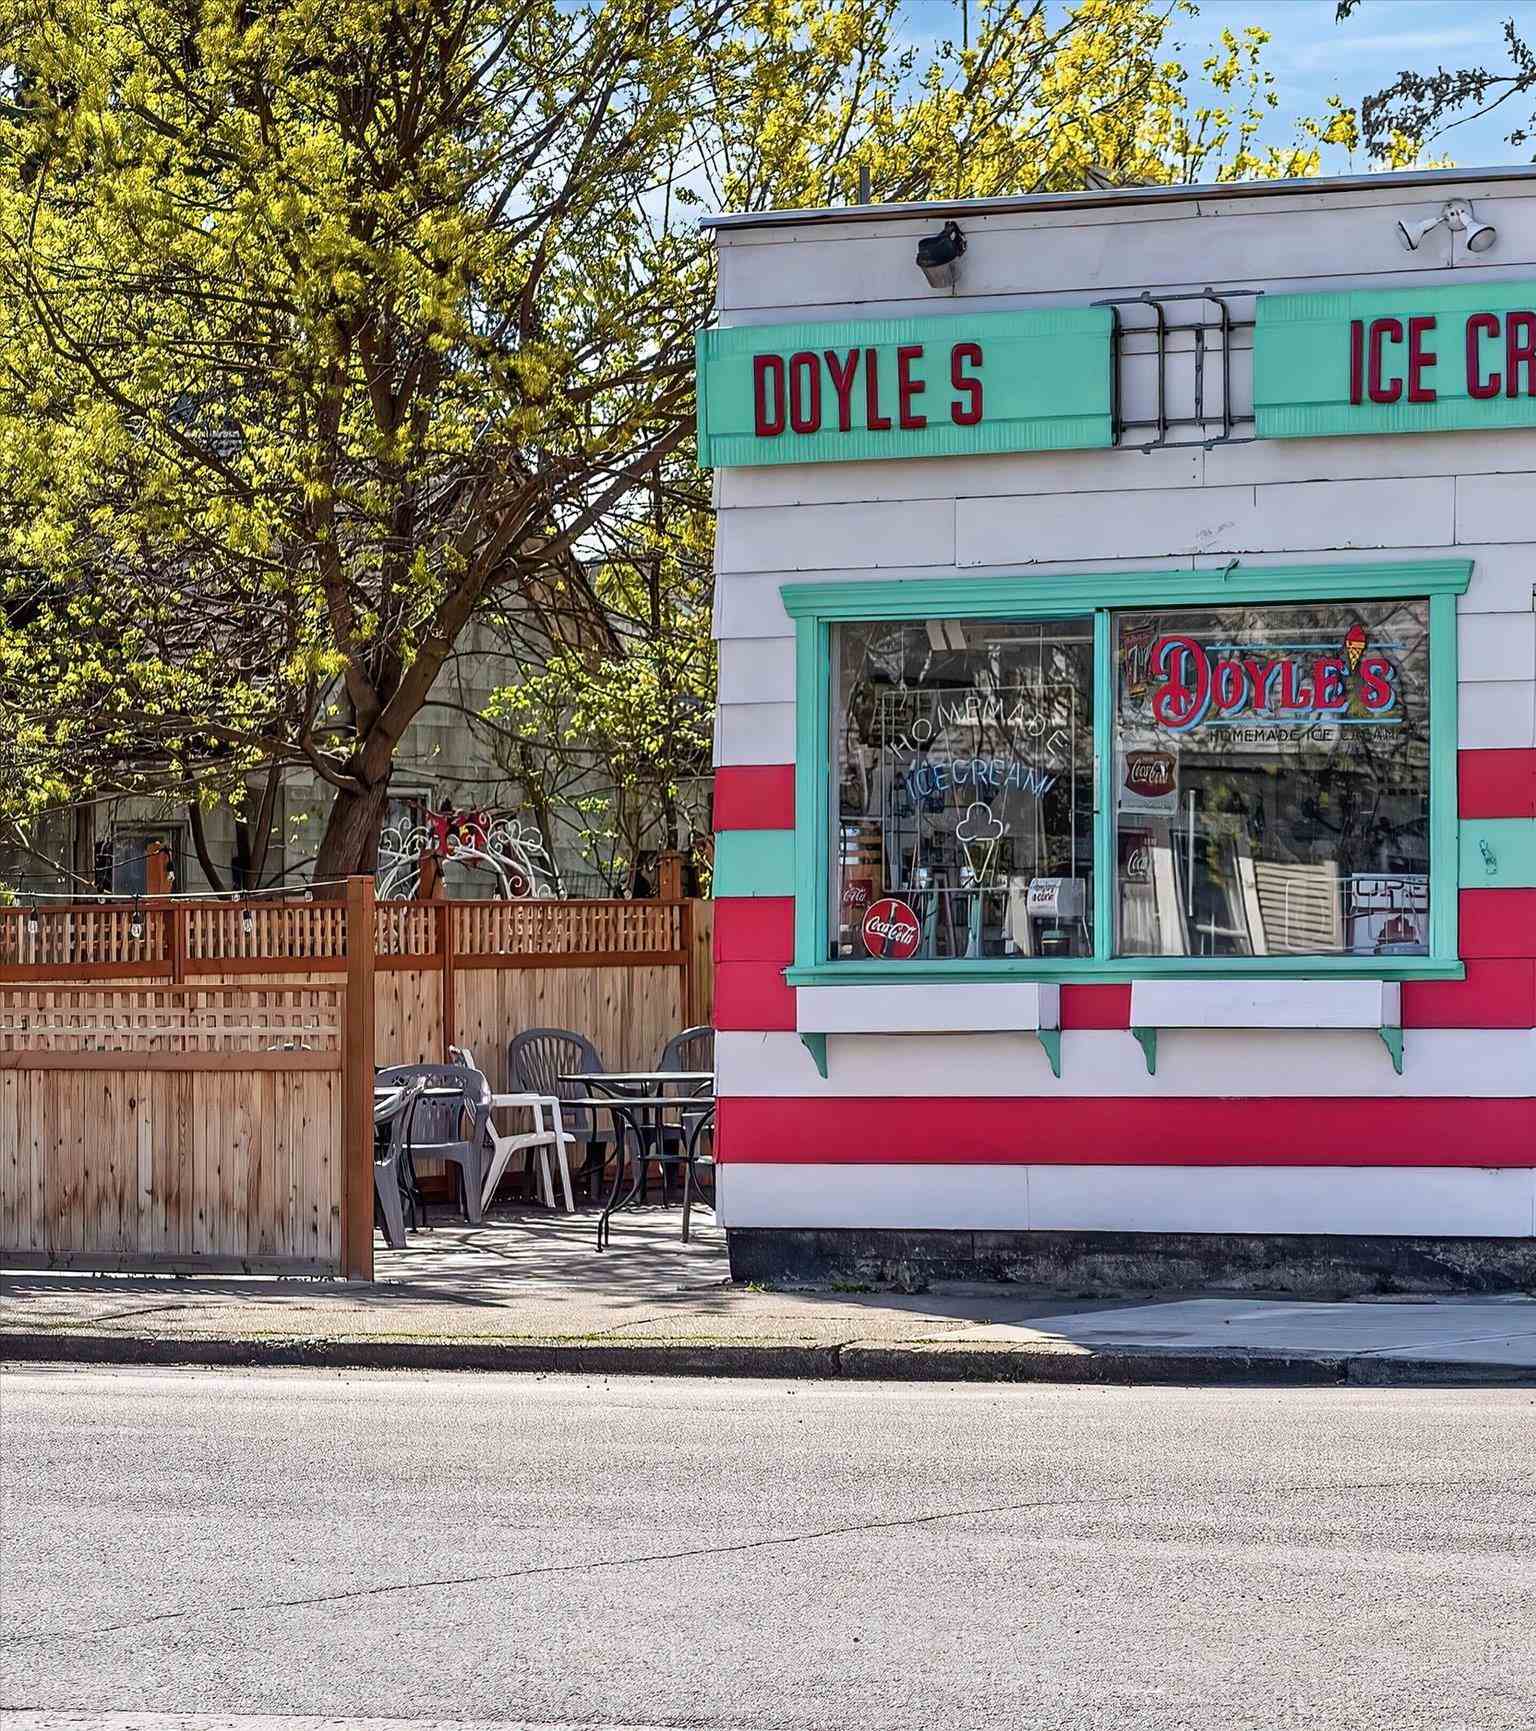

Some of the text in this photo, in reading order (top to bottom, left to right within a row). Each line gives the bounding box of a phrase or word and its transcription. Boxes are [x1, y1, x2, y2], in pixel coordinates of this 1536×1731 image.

[752, 342, 983, 438] DOYLE S
[1349, 315, 1437, 406] ICE
[890, 697, 1069, 760] HOMEMADE
[1208, 727, 1300, 743] HOMEMADE
